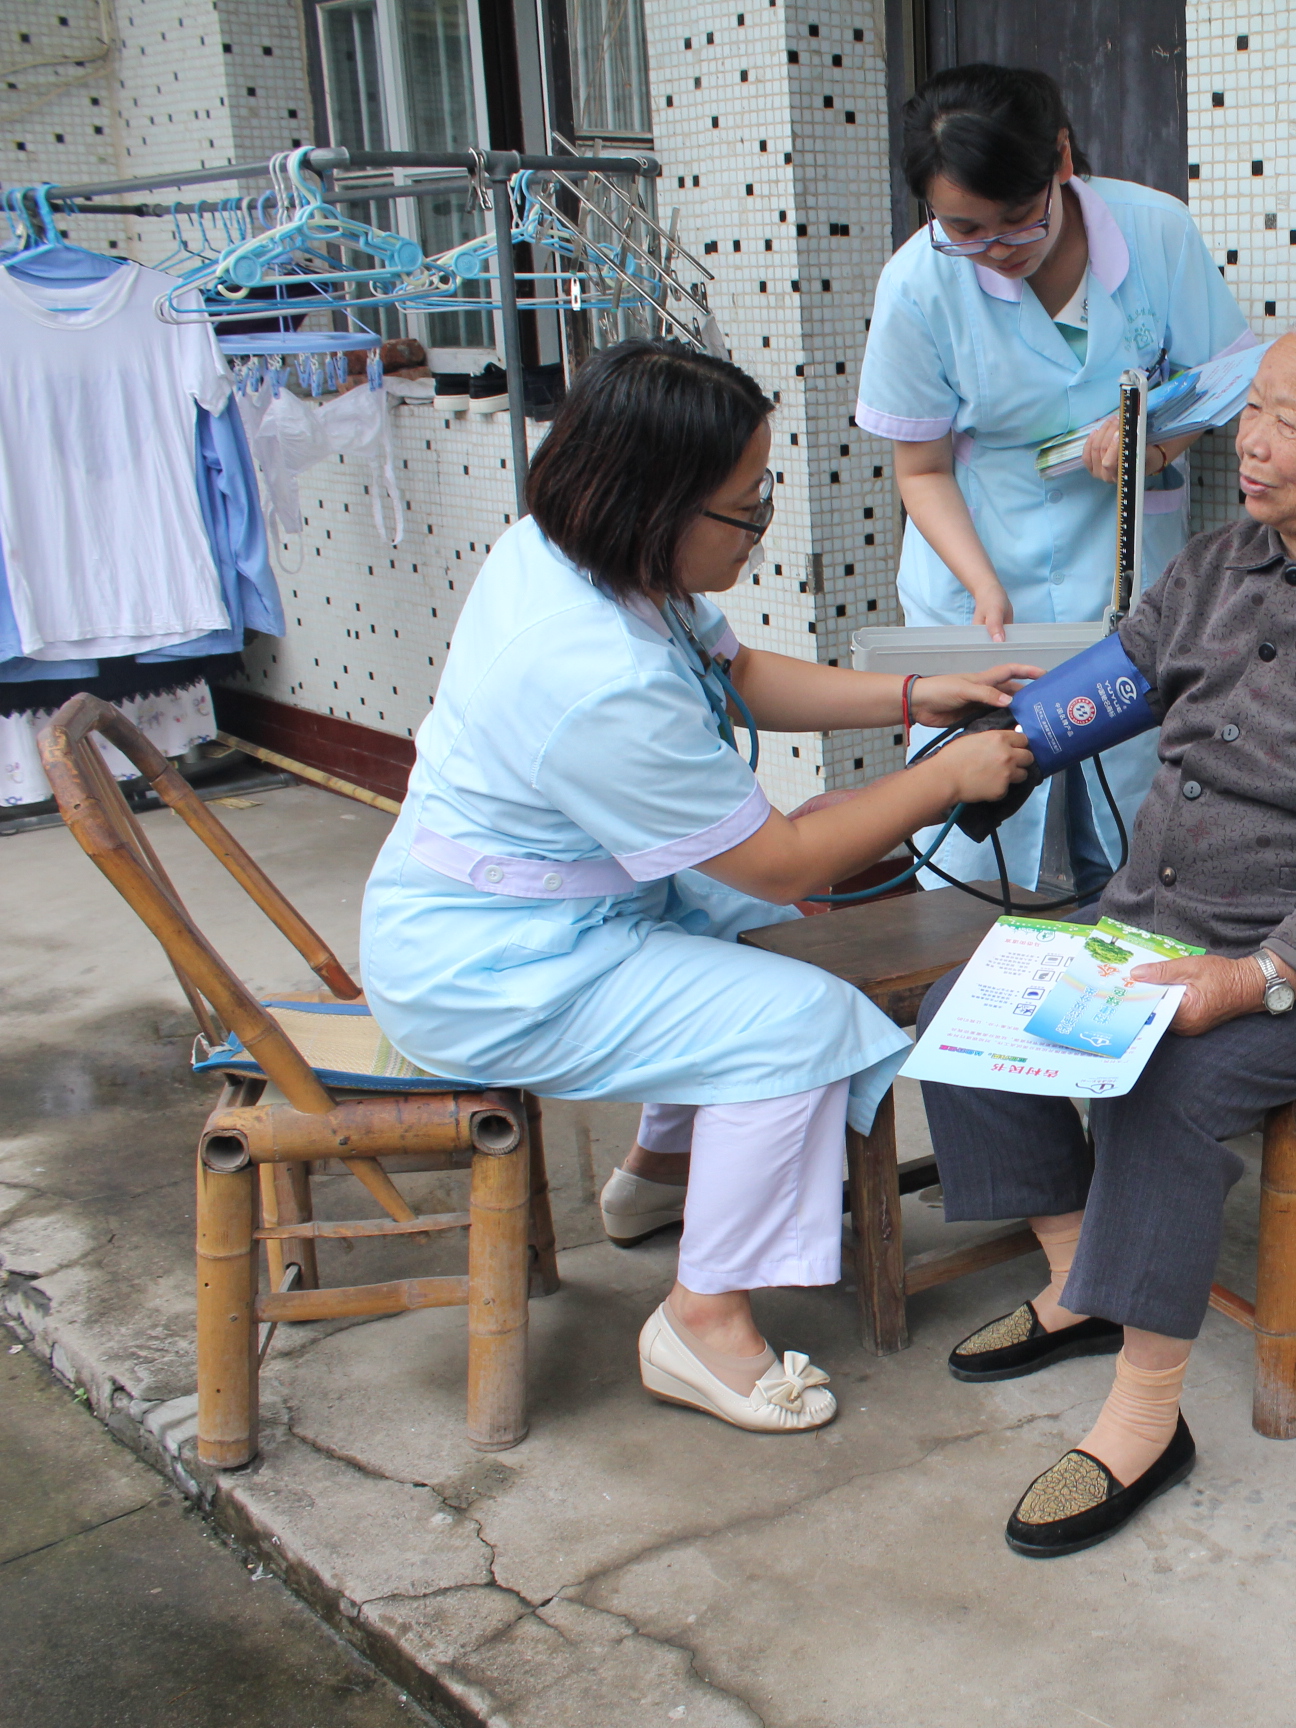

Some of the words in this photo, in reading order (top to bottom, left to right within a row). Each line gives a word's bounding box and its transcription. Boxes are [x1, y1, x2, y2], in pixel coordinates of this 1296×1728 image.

[1105, 680, 1122, 713] YUYUE
[990, 1063, 1060, 1079] 告村民书
